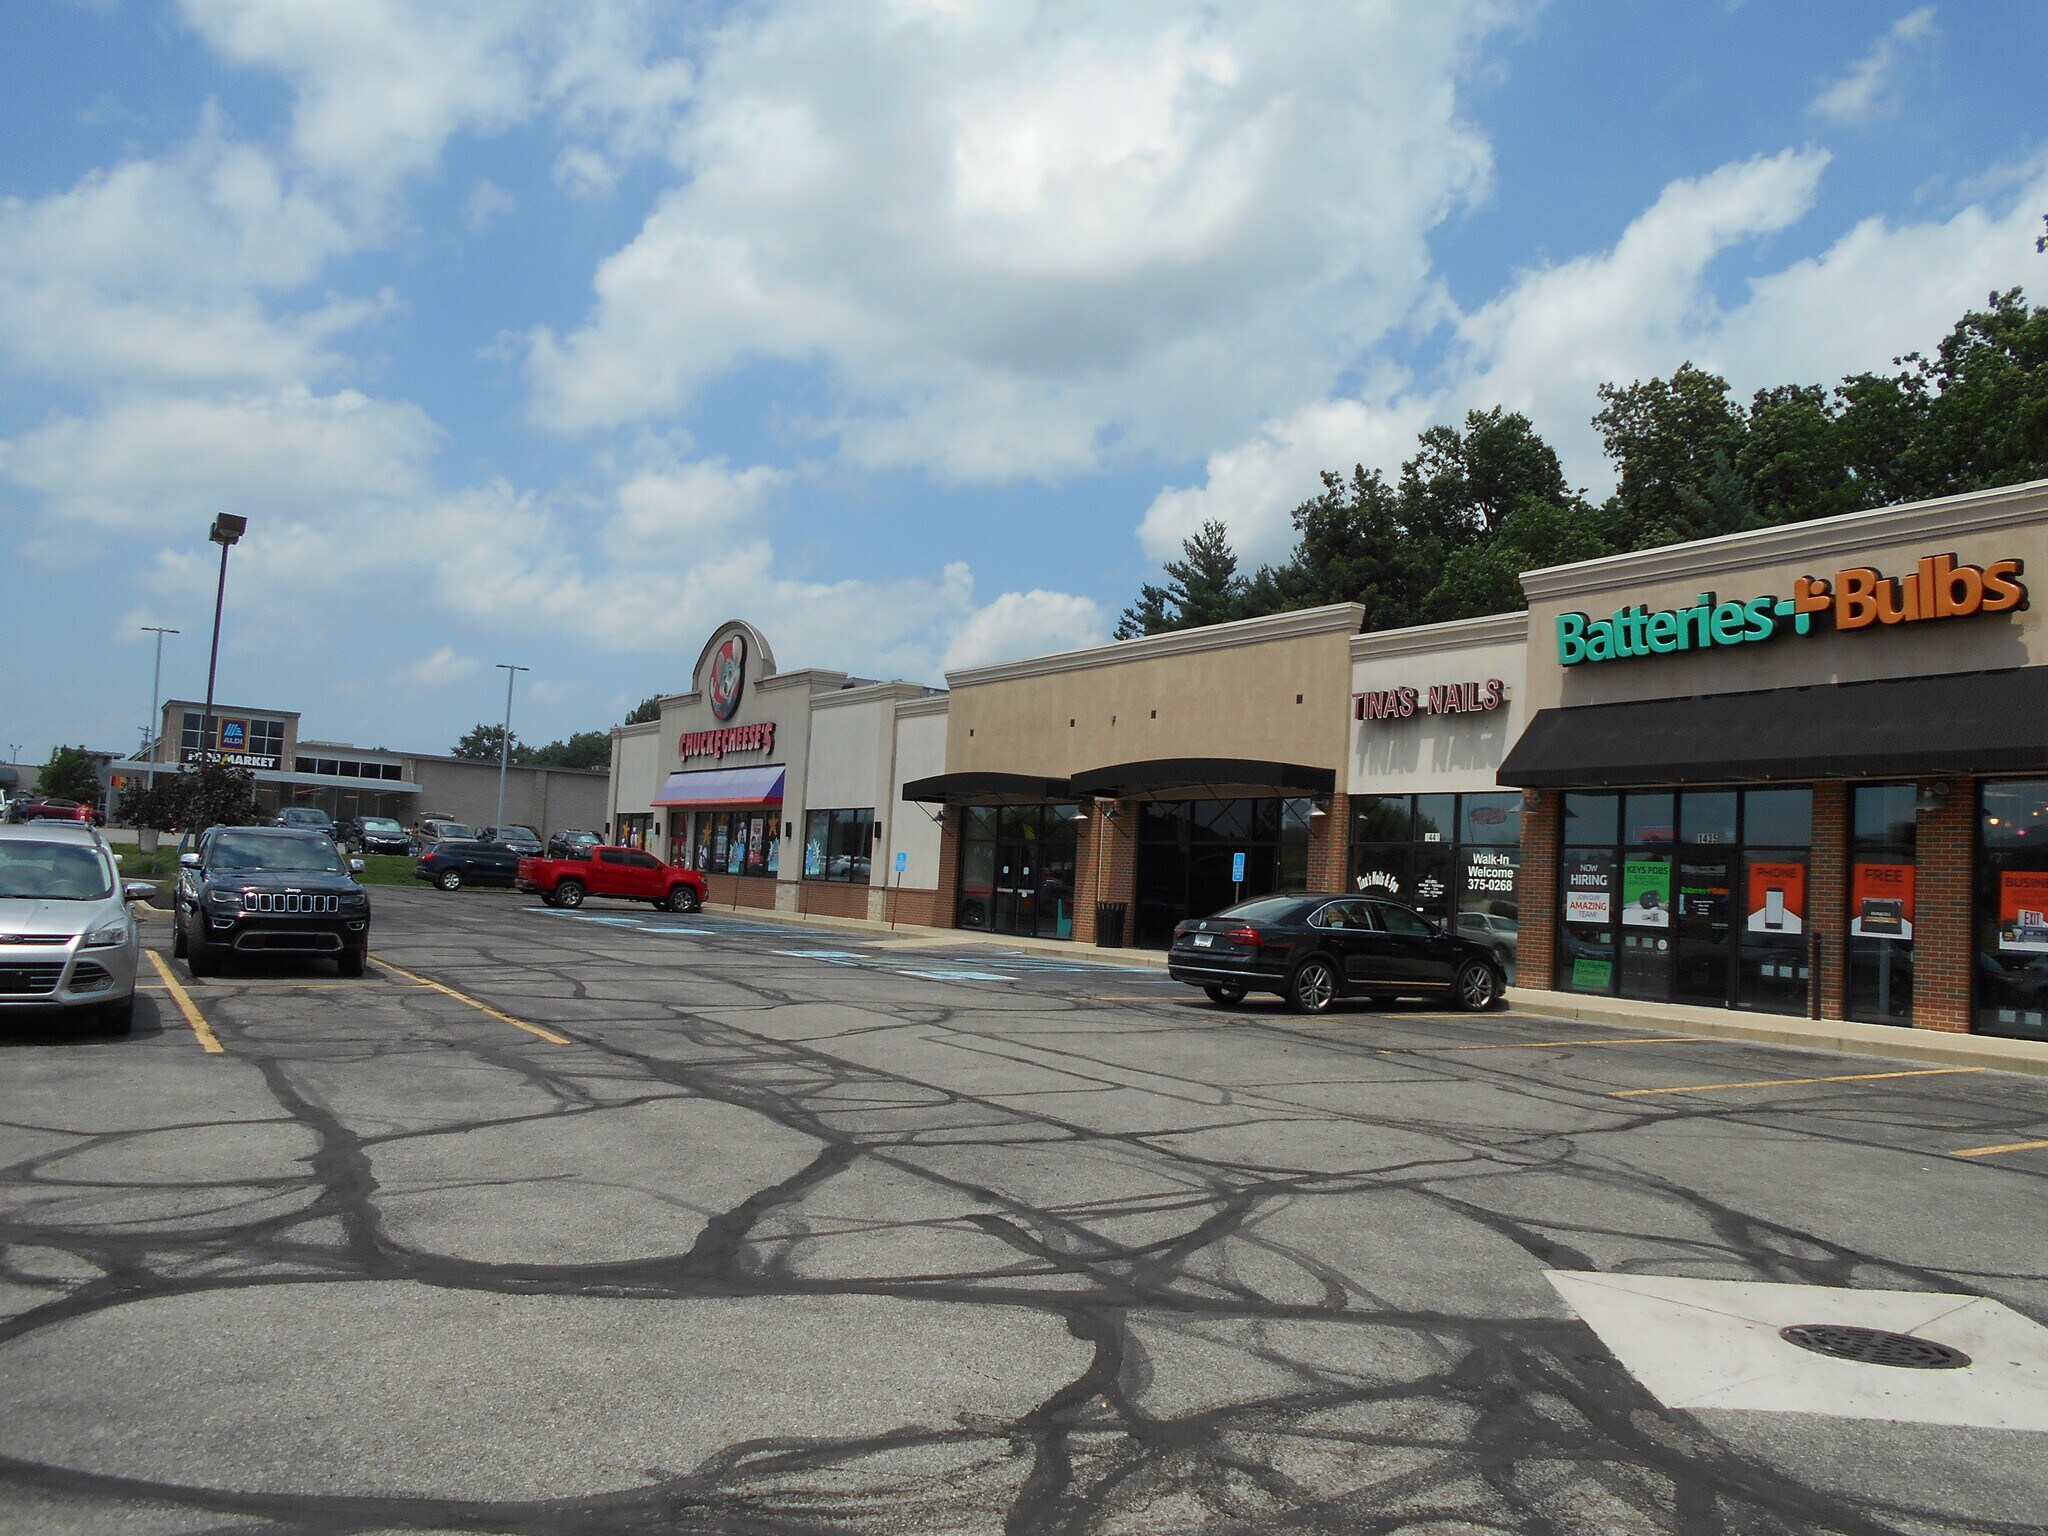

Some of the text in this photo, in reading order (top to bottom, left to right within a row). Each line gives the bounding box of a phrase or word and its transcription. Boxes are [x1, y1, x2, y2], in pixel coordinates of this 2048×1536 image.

[1555, 592, 1776, 667] Batteries
[1834, 553, 2026, 631] Bulbs
[1352, 678, 1504, 720] TINA'S NAILS
[223, 737, 243, 745] ALDI
[227, 753, 275, 768] MARKET
[1697, 832, 1719, 844] 1435
[1472, 853, 1510, 865] Walk-In
[1467, 865, 1514, 878] Welcome
[1579, 864, 1598, 872] NOW
[1647, 866, 1669, 875] FOBS
[1570, 874, 1608, 886] HIRING
[1864, 868, 1904, 883] FREE
[1467, 878, 1513, 891] 375-0268
[1569, 901, 1607, 911] AMAZING
[1578, 910, 1598, 918] TEAM!
[2024, 911, 2040, 926] EXIT
